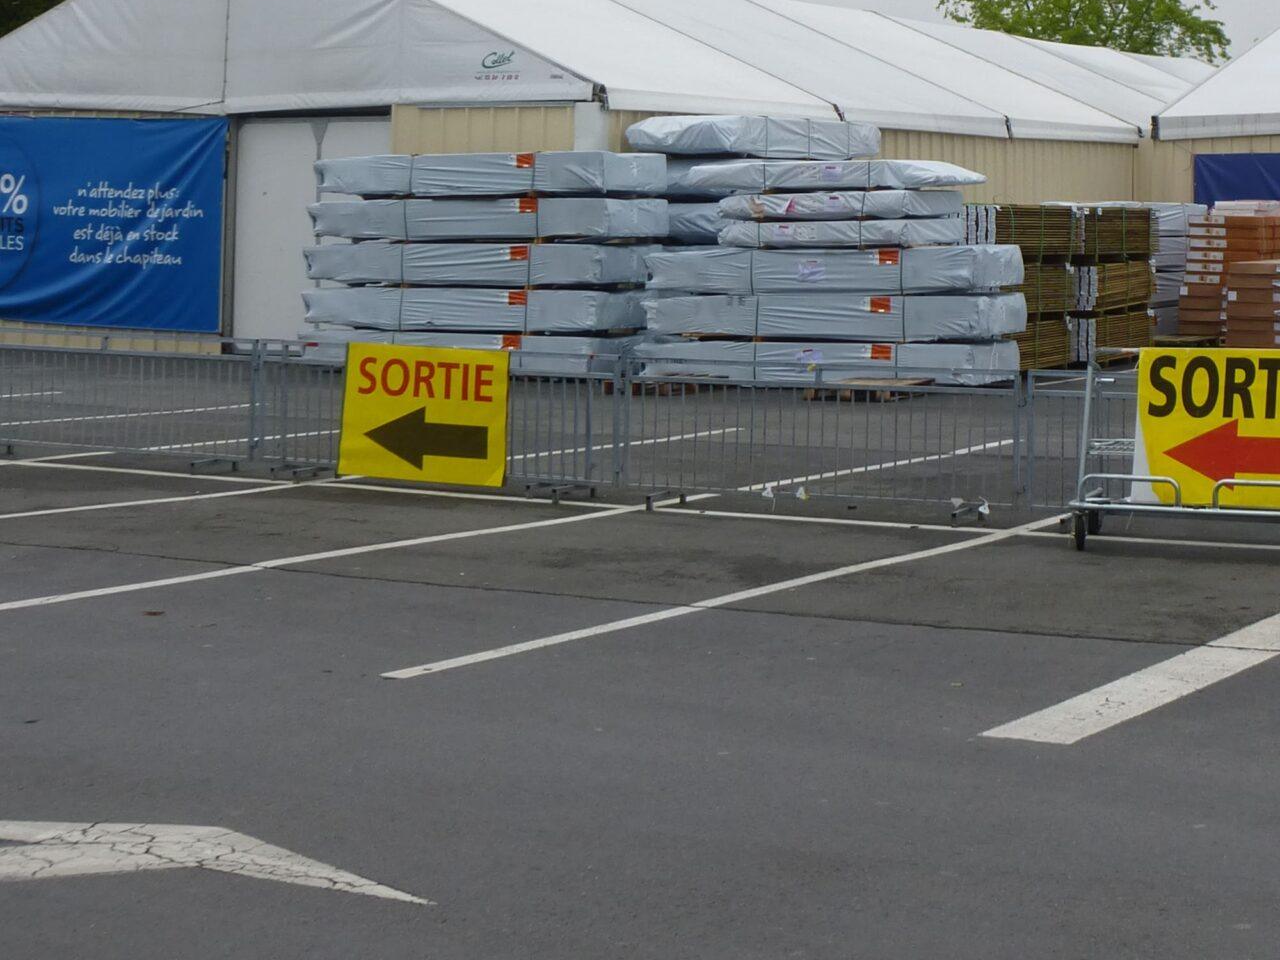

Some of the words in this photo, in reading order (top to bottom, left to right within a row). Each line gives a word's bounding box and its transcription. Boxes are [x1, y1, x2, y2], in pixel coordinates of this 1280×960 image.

[77, 181, 145, 199] n'attendez
[53, 199, 86, 217] votre
[88, 199, 142, 218] mobilier
[146, 200, 159, 218] de
[158, 200, 204, 222] jardin
[73, 222, 93, 241] est
[95, 223, 123, 246] déjà
[126, 230, 140, 241] en
[143, 223, 179, 242] stock
[69, 245, 102, 264] dans
[103, 245, 114, 264] le
[116, 245, 183, 270] chapiteau
[357, 356, 495, 403] SORTIE
